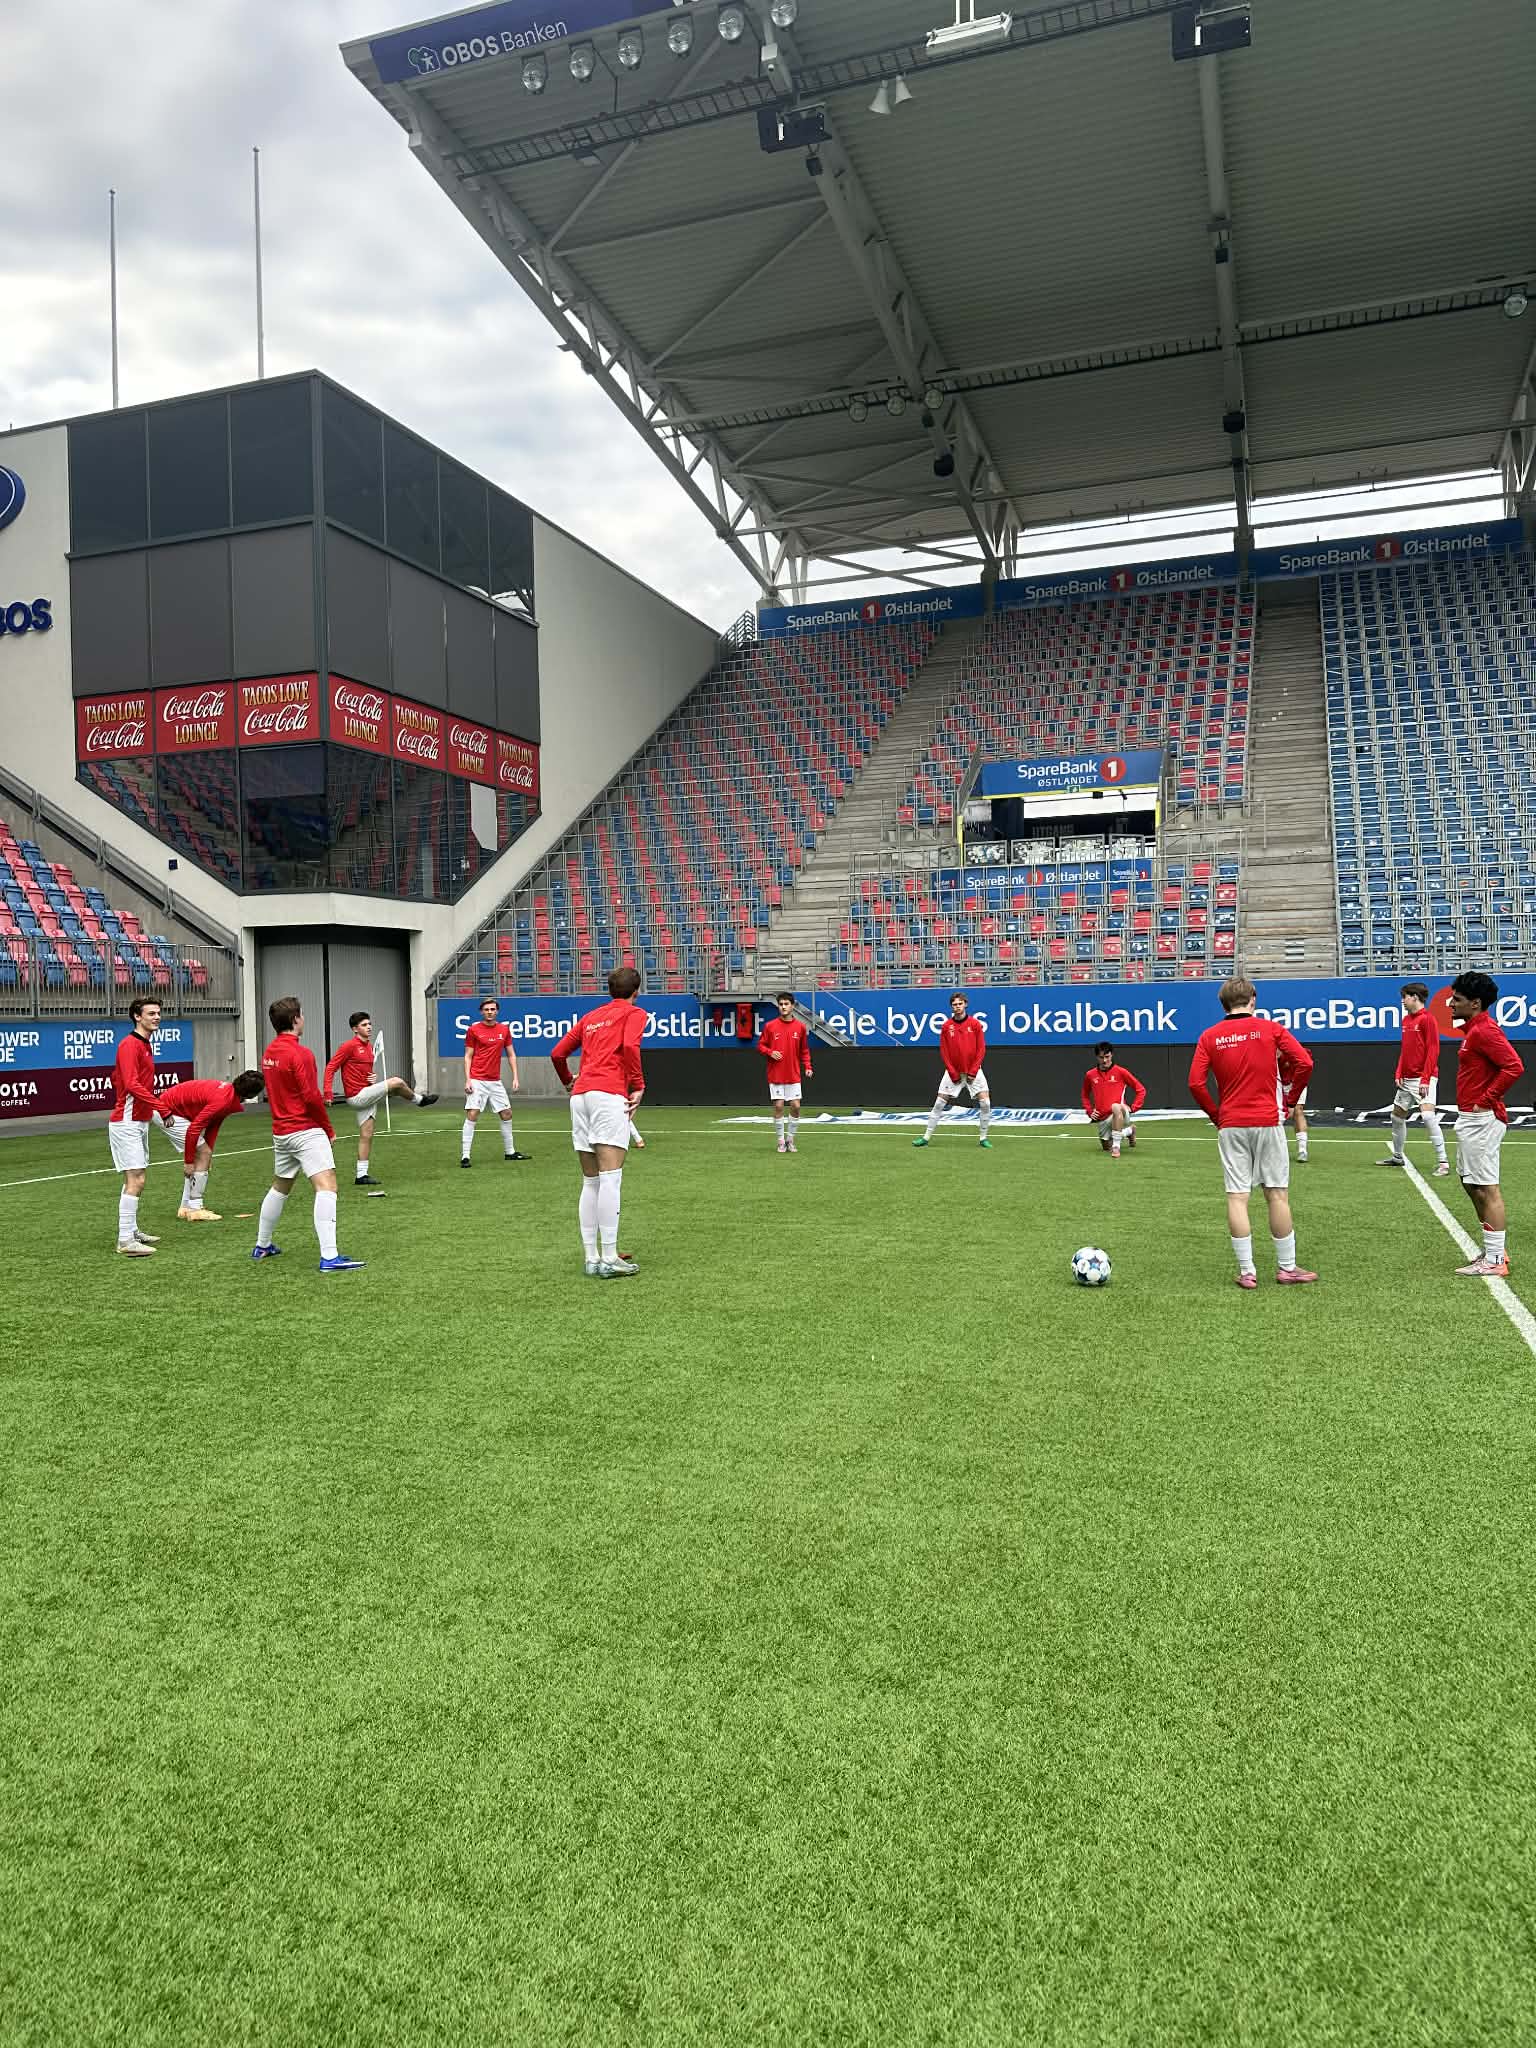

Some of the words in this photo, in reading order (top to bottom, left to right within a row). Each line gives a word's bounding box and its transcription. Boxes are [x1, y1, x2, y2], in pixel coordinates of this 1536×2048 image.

[442, 35, 500, 66] OBOS
[501, 21, 568, 52] Banken
[1280, 546, 1371, 572] SpareBank
[1381, 542, 1392, 558] 1
[1404, 533, 1491, 555] Østlandet
[1025, 577, 1108, 602] SpareBank
[1115, 573, 1125, 589] 1
[1136, 565, 1214, 587] Østlandet
[0, 598, 52, 635] OS
[786, 608, 859, 630] SpareBank
[866, 604, 875, 618] 1
[885, 597, 953, 617] Østlandet
[163, 689, 227, 723] Coca-Cola
[243, 685, 278, 706] TACOS
[279, 680, 309, 703] LOVE
[335, 685, 384, 721] Coca-Cola
[85, 702, 117, 724] TACOS
[118, 699, 146, 721] LOVE
[244, 702, 311, 736] Coca-Cola
[395, 704, 419, 729] TACOS
[419, 712, 439, 736] LOVE
[86, 720, 147, 752] Coca-Cola
[175, 721, 219, 744] LOUNGE
[344, 716, 379, 744] LOUNGE
[397, 728, 440, 761] Coca-Cola
[450, 724, 488, 755] Coca-Cola
[457, 751, 485, 775] LOUNGE
[1017, 759, 1098, 779] SpareBank
[1107, 760, 1118, 778] 1
[1037, 775, 1099, 787] ØSTLANDET
[1045, 869, 1100, 883] Øtlandet
[149, 1028, 181, 1042] WER
[642, 1011, 764, 1038] Østlandt
[819, 1009, 876, 1036] ele
[887, 1006, 989, 1041] byes
[1000, 1000, 1178, 1034] lokalbank
[63, 1029, 114, 1045] POWER
[64, 1044, 94, 1060] ADE
[69, 1077, 113, 1092] COSTA
